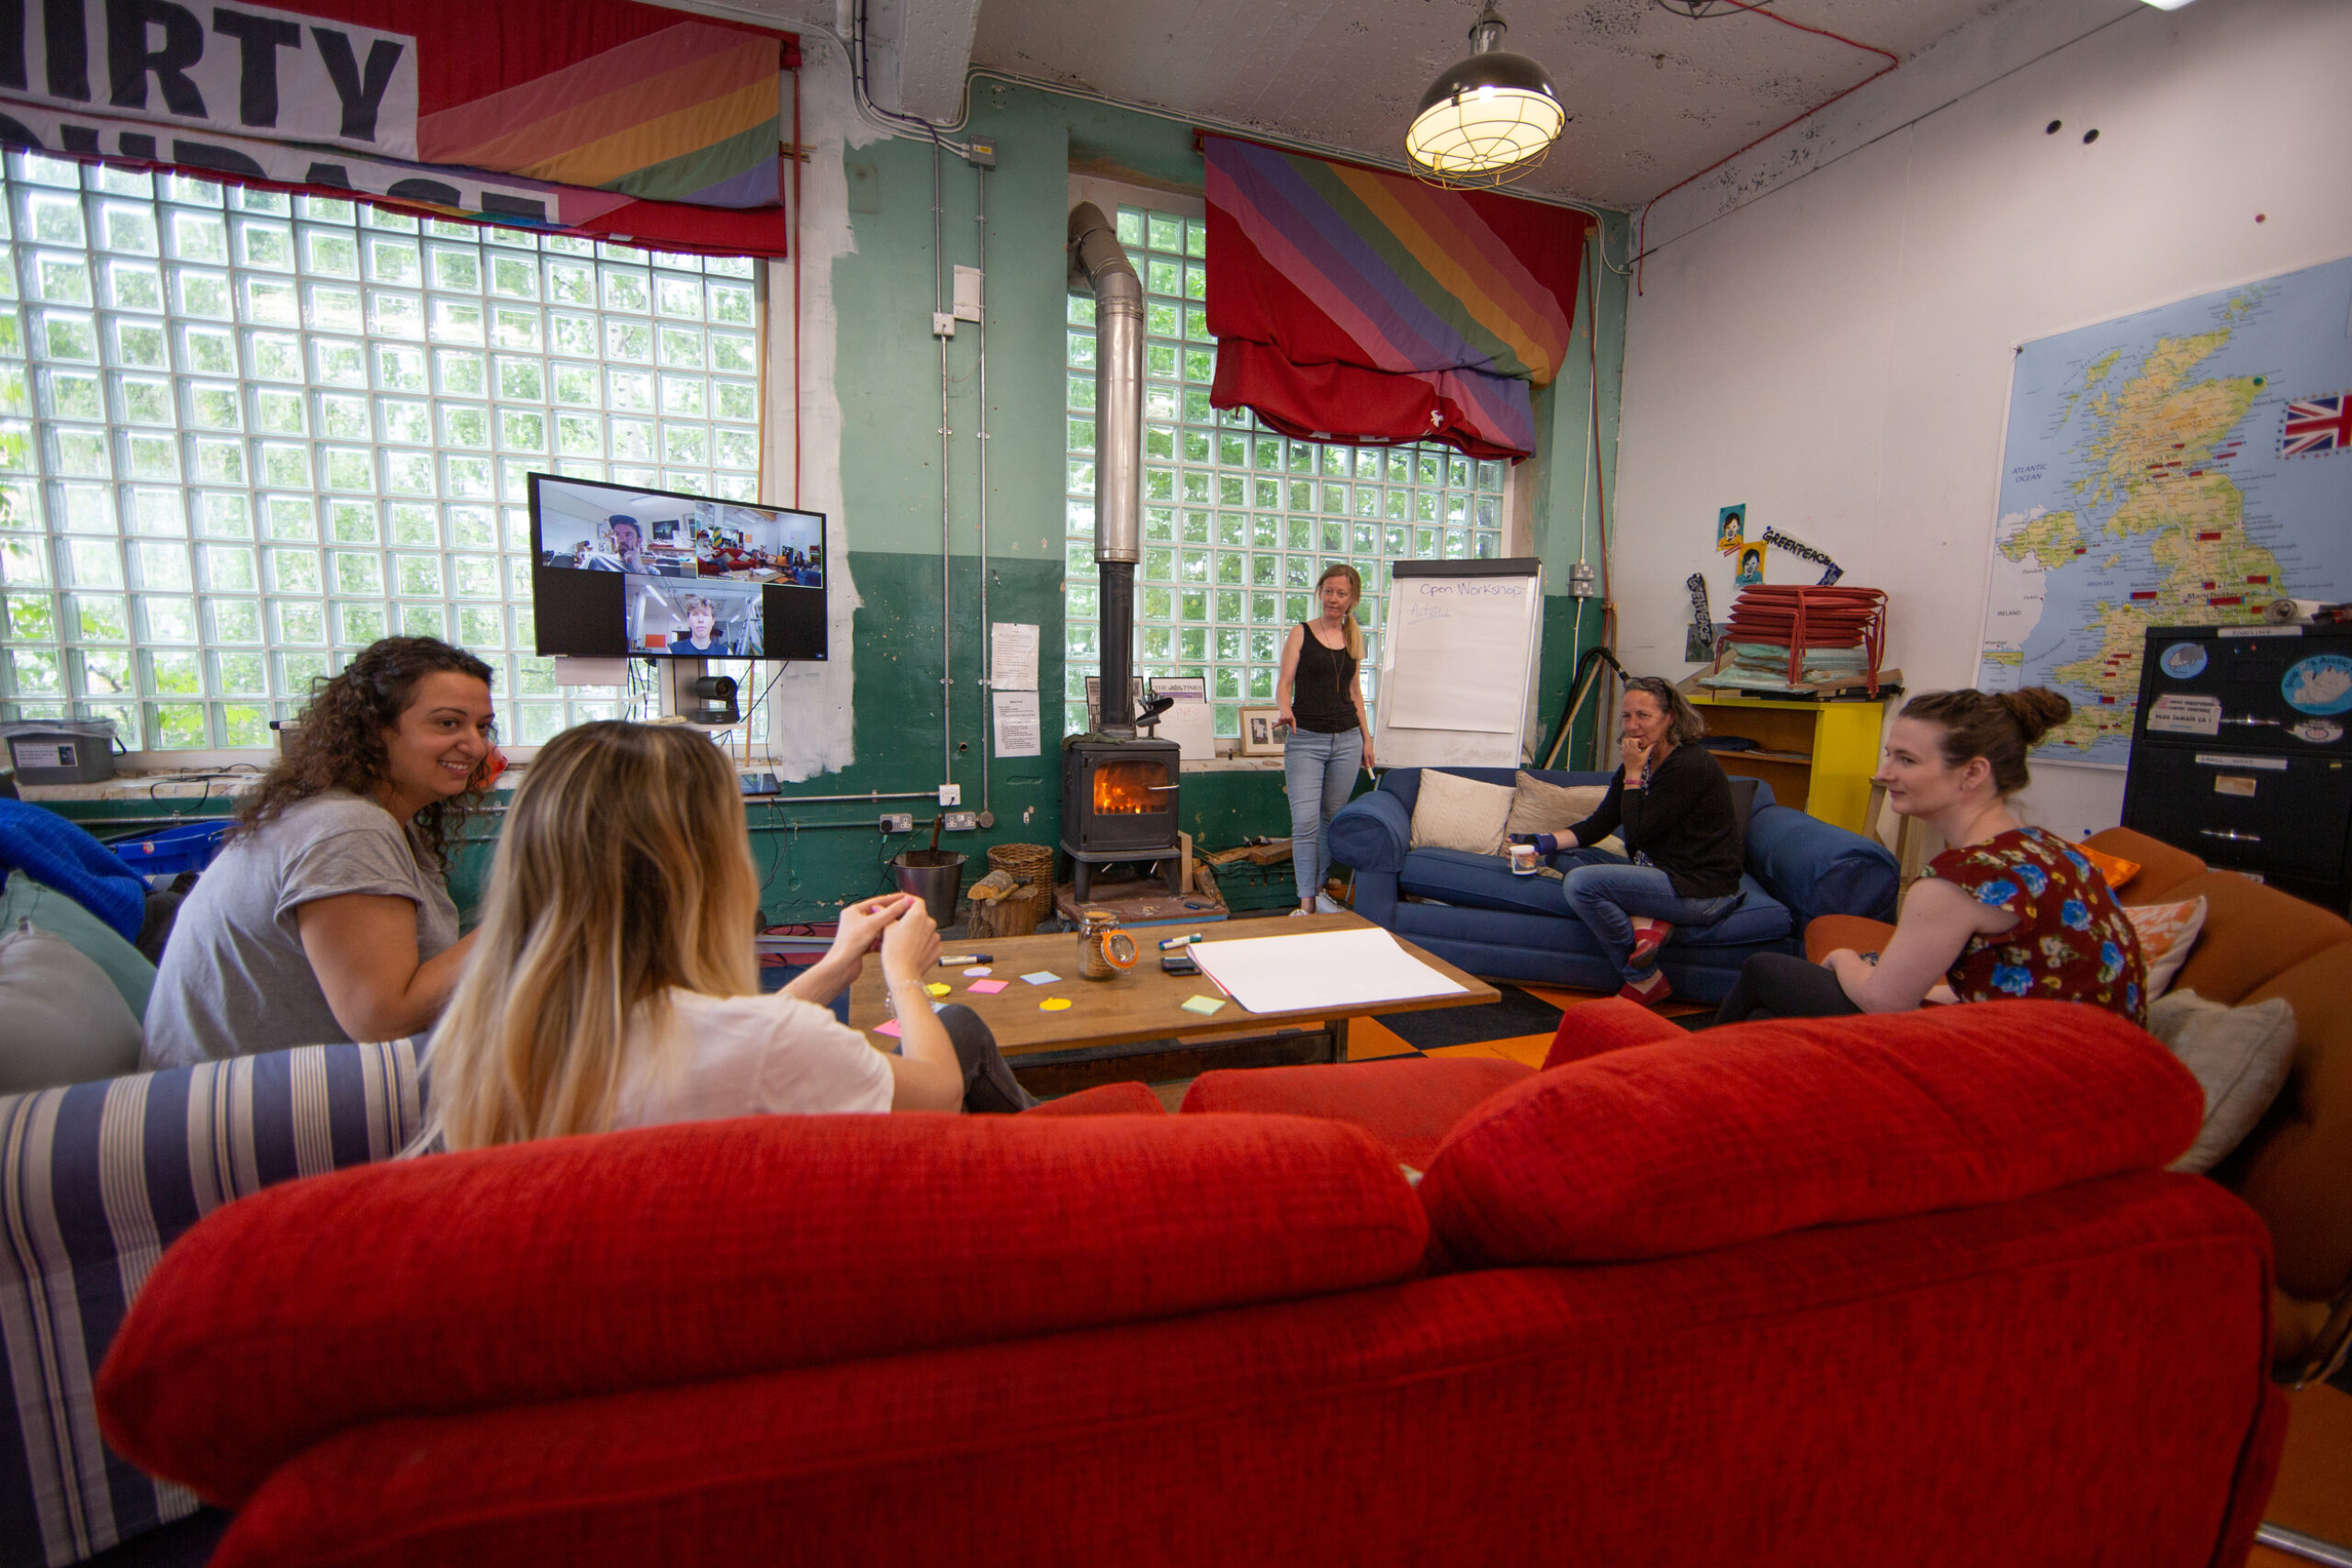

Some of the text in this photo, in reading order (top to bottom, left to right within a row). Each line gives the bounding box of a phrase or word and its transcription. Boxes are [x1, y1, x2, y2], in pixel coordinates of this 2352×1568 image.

[2012, 463, 2049, 475] ATLANTIC
[2015, 473, 2042, 483] OCEAN
[1762, 530, 1831, 566] GREENPEACE
[1419, 582, 1453, 597] Open
